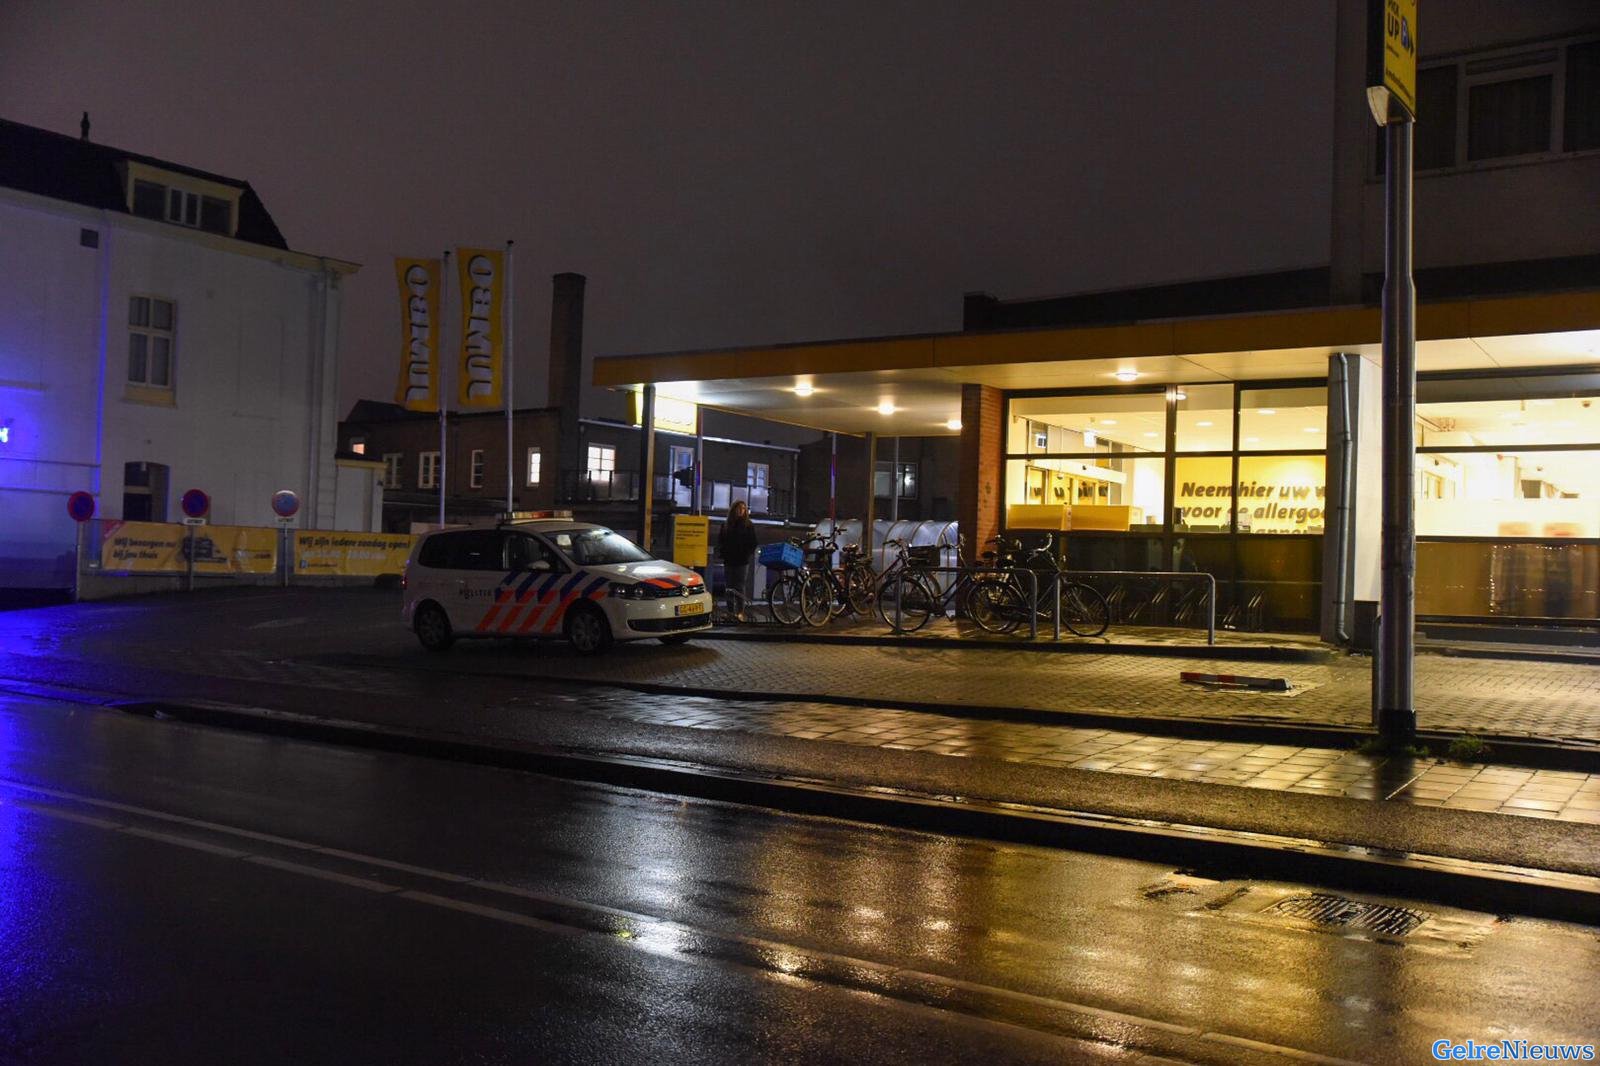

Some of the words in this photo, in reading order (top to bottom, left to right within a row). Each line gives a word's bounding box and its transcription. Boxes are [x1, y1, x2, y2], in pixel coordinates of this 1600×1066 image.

[1181, 482, 1233, 497] Neem
[1237, 481, 1274, 497] hier
[1278, 486, 1310, 498] uw
[1182, 506, 1222, 518] voor
